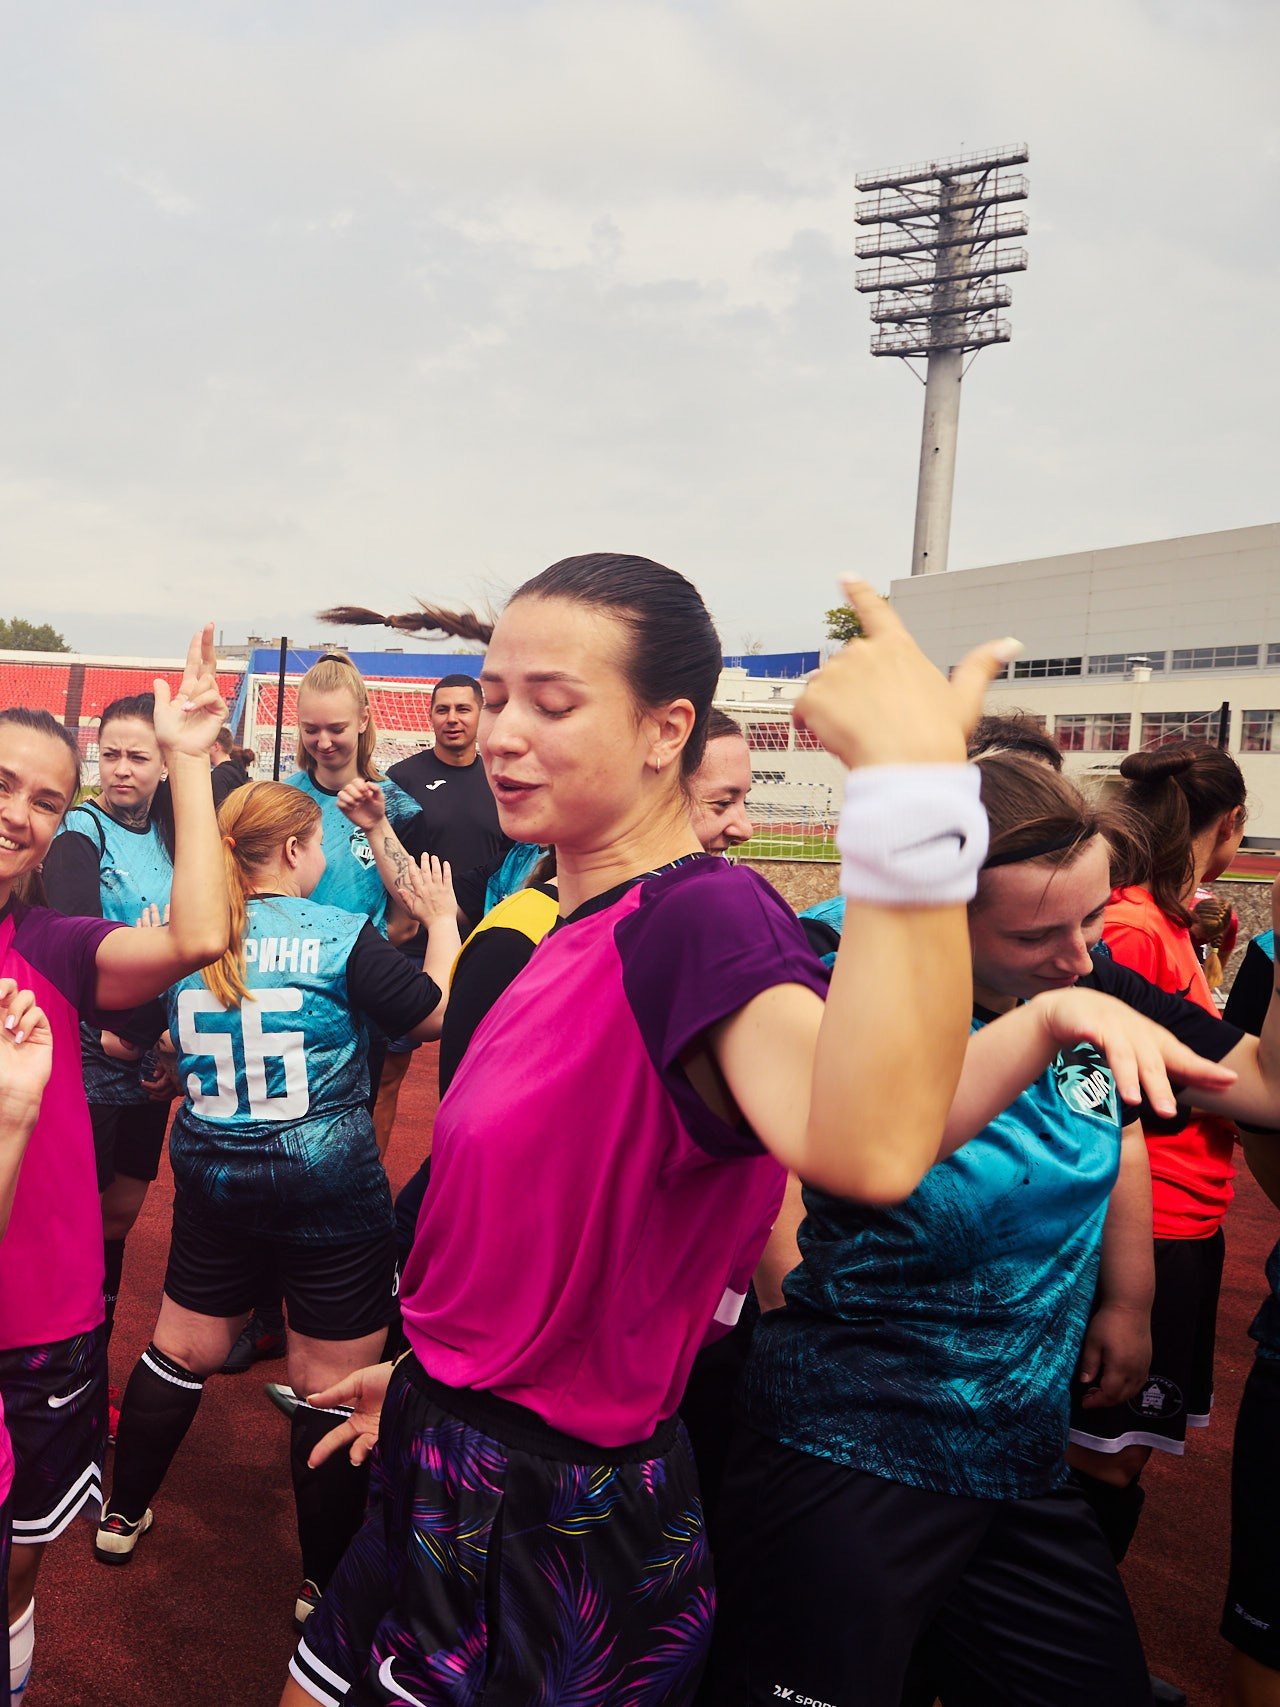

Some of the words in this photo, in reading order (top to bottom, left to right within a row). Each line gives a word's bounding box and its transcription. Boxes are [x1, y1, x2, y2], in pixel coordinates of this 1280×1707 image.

[242, 937, 320, 973] РИНА
[177, 987, 310, 1121] 56
[1070, 1070, 1112, 1112] ALTAIR
[794, 1694, 837, 1707] SPO
